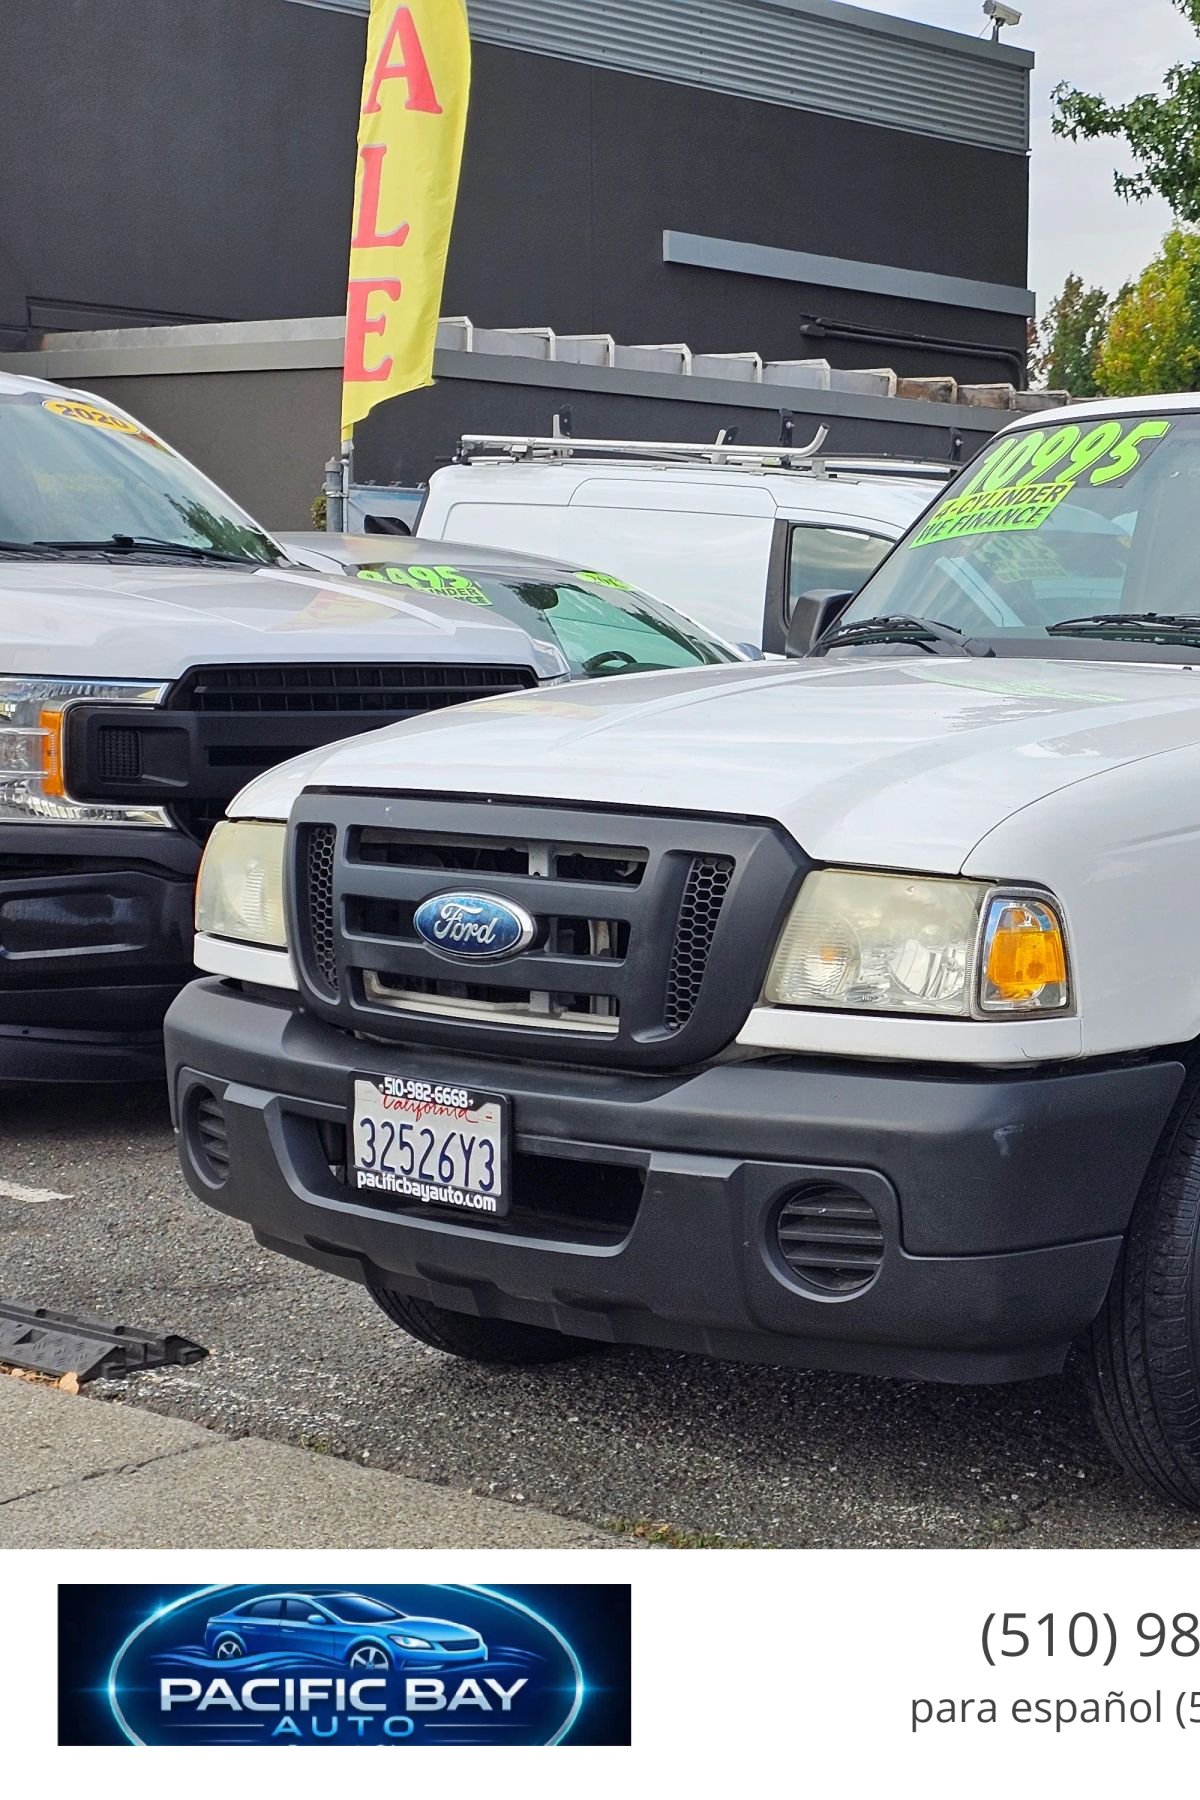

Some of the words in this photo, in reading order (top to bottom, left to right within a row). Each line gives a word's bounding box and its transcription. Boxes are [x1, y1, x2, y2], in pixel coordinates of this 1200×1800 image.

[55, 404, 129, 429] 2020
[959, 421, 1172, 497] 10995
[935, 484, 1068, 520] 4-CYLINDER
[915, 518, 954, 544] WE
[947, 506, 1050, 534] FINANCE
[433, 902, 499, 945] Ford
[384, 1077, 468, 1108] 510-982-6668
[360, 1117, 495, 1192] 32526Y3
[357, 1171, 497, 1212] pacificbayauto.com
